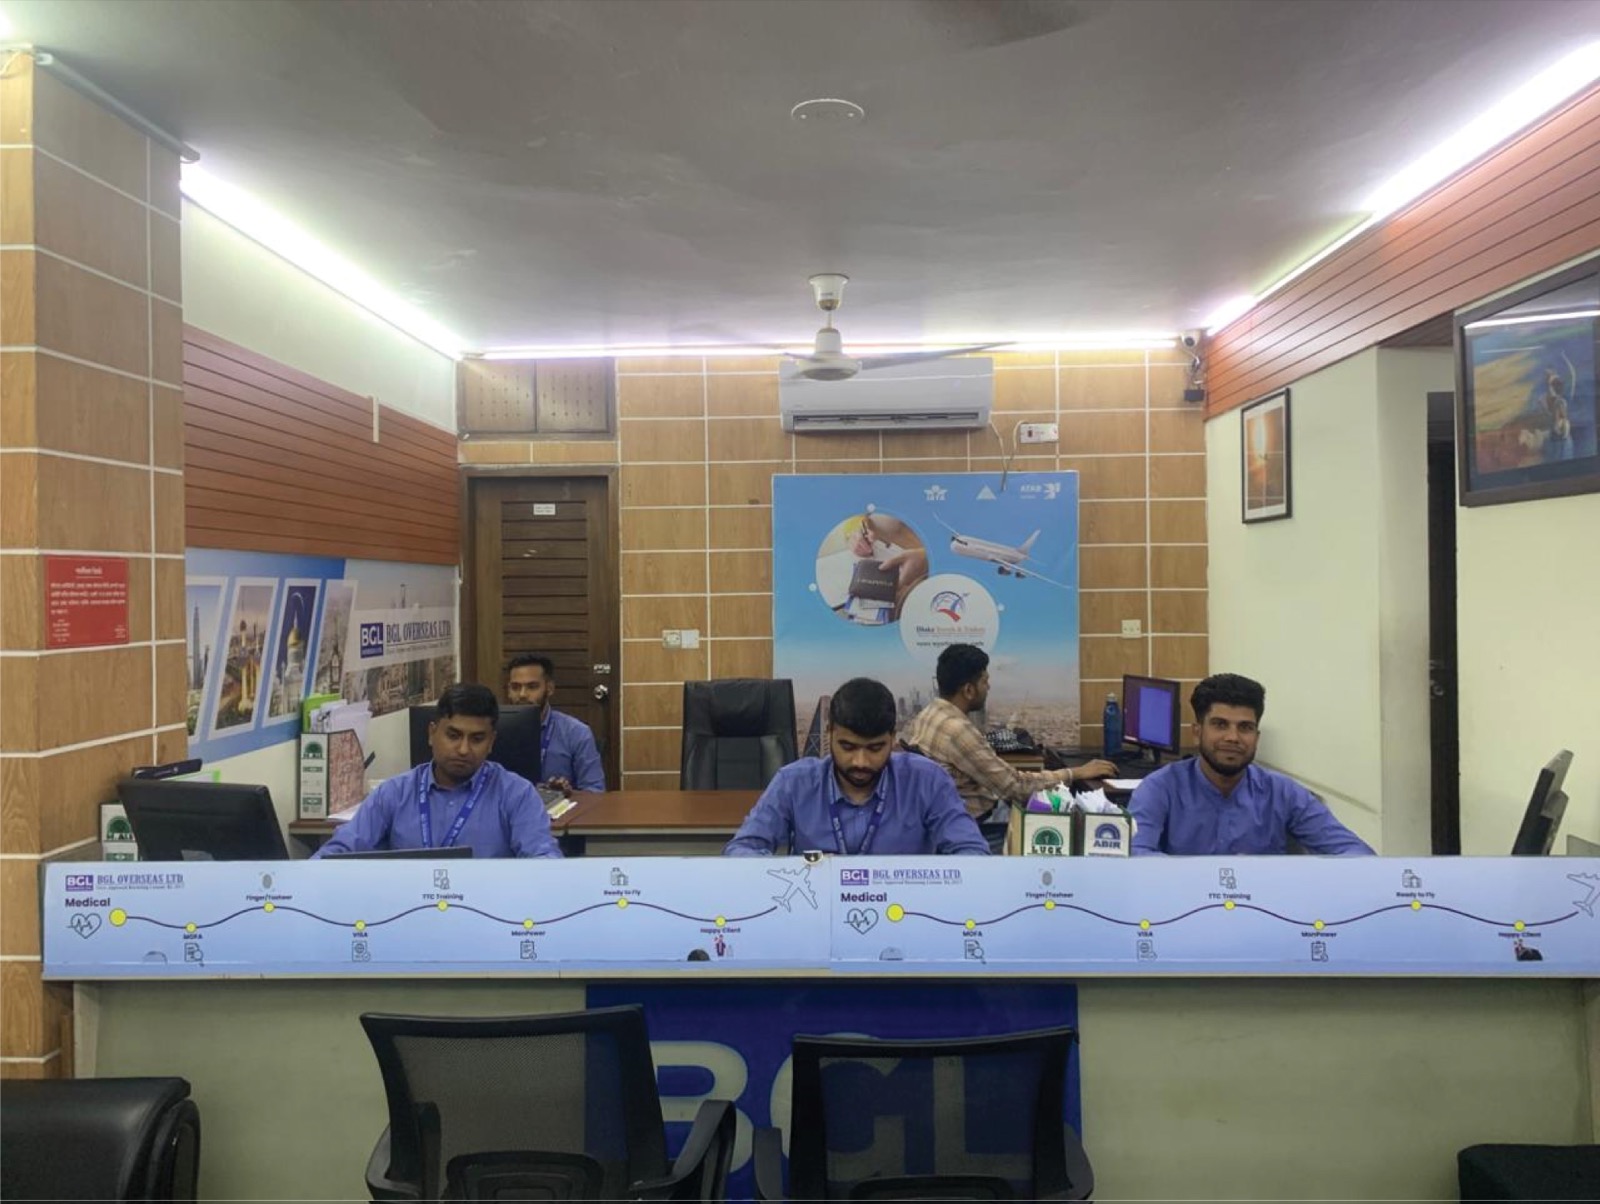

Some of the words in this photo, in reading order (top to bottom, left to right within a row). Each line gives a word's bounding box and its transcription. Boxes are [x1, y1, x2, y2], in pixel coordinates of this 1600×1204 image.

[361, 625, 384, 647] BGL
[386, 623, 401, 644] BGL
[403, 621, 437, 641] OVERSEAS
[1093, 840, 1121, 849] ABIR
[1031, 846, 1062, 855] LUCK
[841, 870, 869, 880] BGL
[872, 869, 890, 879] BGL
[893, 869, 940, 879] OVERSEAS
[67, 876, 93, 886] BGL
[97, 874, 115, 885] BGL
[117, 874, 163, 884] OVERSEAS
[436, 892, 464, 901] Training
[603, 889, 623, 897] Ready
[840, 892, 887, 902] Medical
[1222, 892, 1251, 901] Training
[1396, 891, 1417, 899] Ready
[65, 898, 111, 908] Medical
[962, 930, 983, 938] MOFA
[643, 1032, 1034, 1182] BGL
